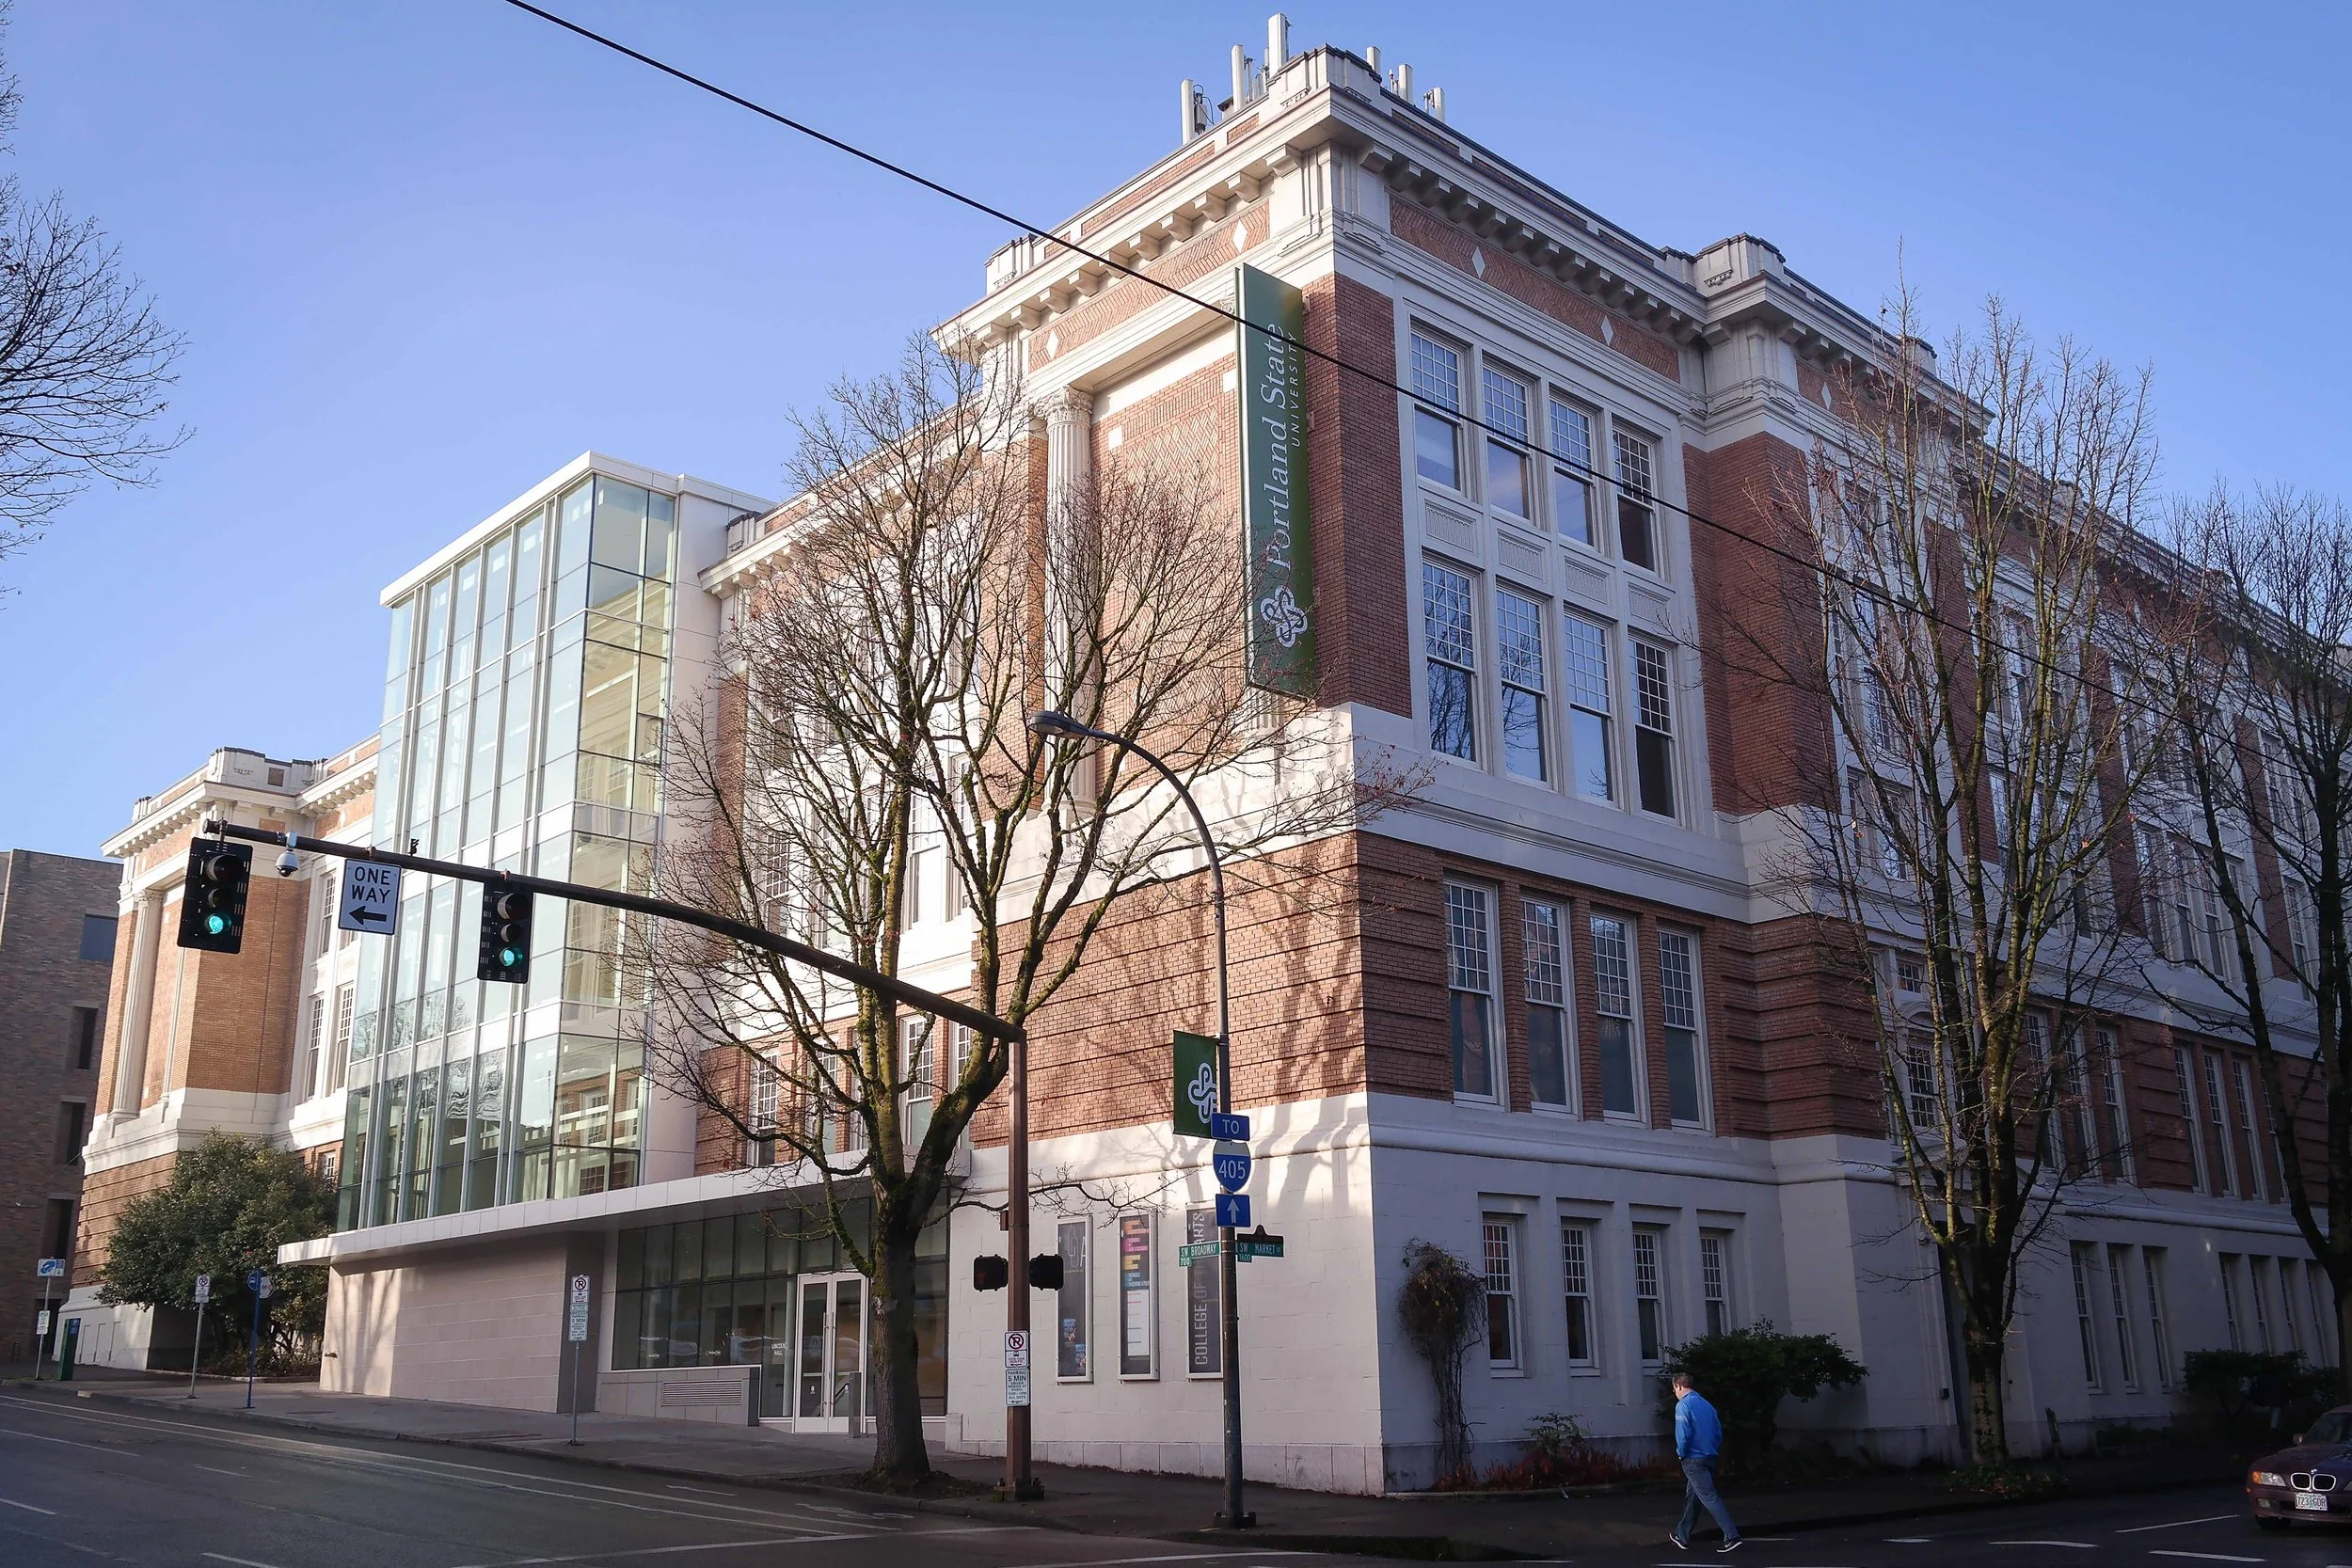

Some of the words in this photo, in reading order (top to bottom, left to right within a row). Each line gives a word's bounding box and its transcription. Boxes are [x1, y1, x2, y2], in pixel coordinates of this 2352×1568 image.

[1260, 324, 1286, 410] State
[1288, 332, 1300, 447] UNIVERSITY
[1261, 416, 1291, 572] Portland
[354, 866, 391, 886] ONE
[351, 884, 390, 904] WAY
[1222, 1119, 1239, 1134] TO
[1218, 1159, 1246, 1180] 405
[1181, 1246, 1188, 1258] SW
[1190, 1243, 1217, 1257] BROADWAY
[1239, 1242, 1248, 1253] SW
[1254, 1243, 1276, 1255] MARKET
[1193, 1281, 1207, 1298] OF
[1194, 1303, 1208, 1365] COLLEGE
